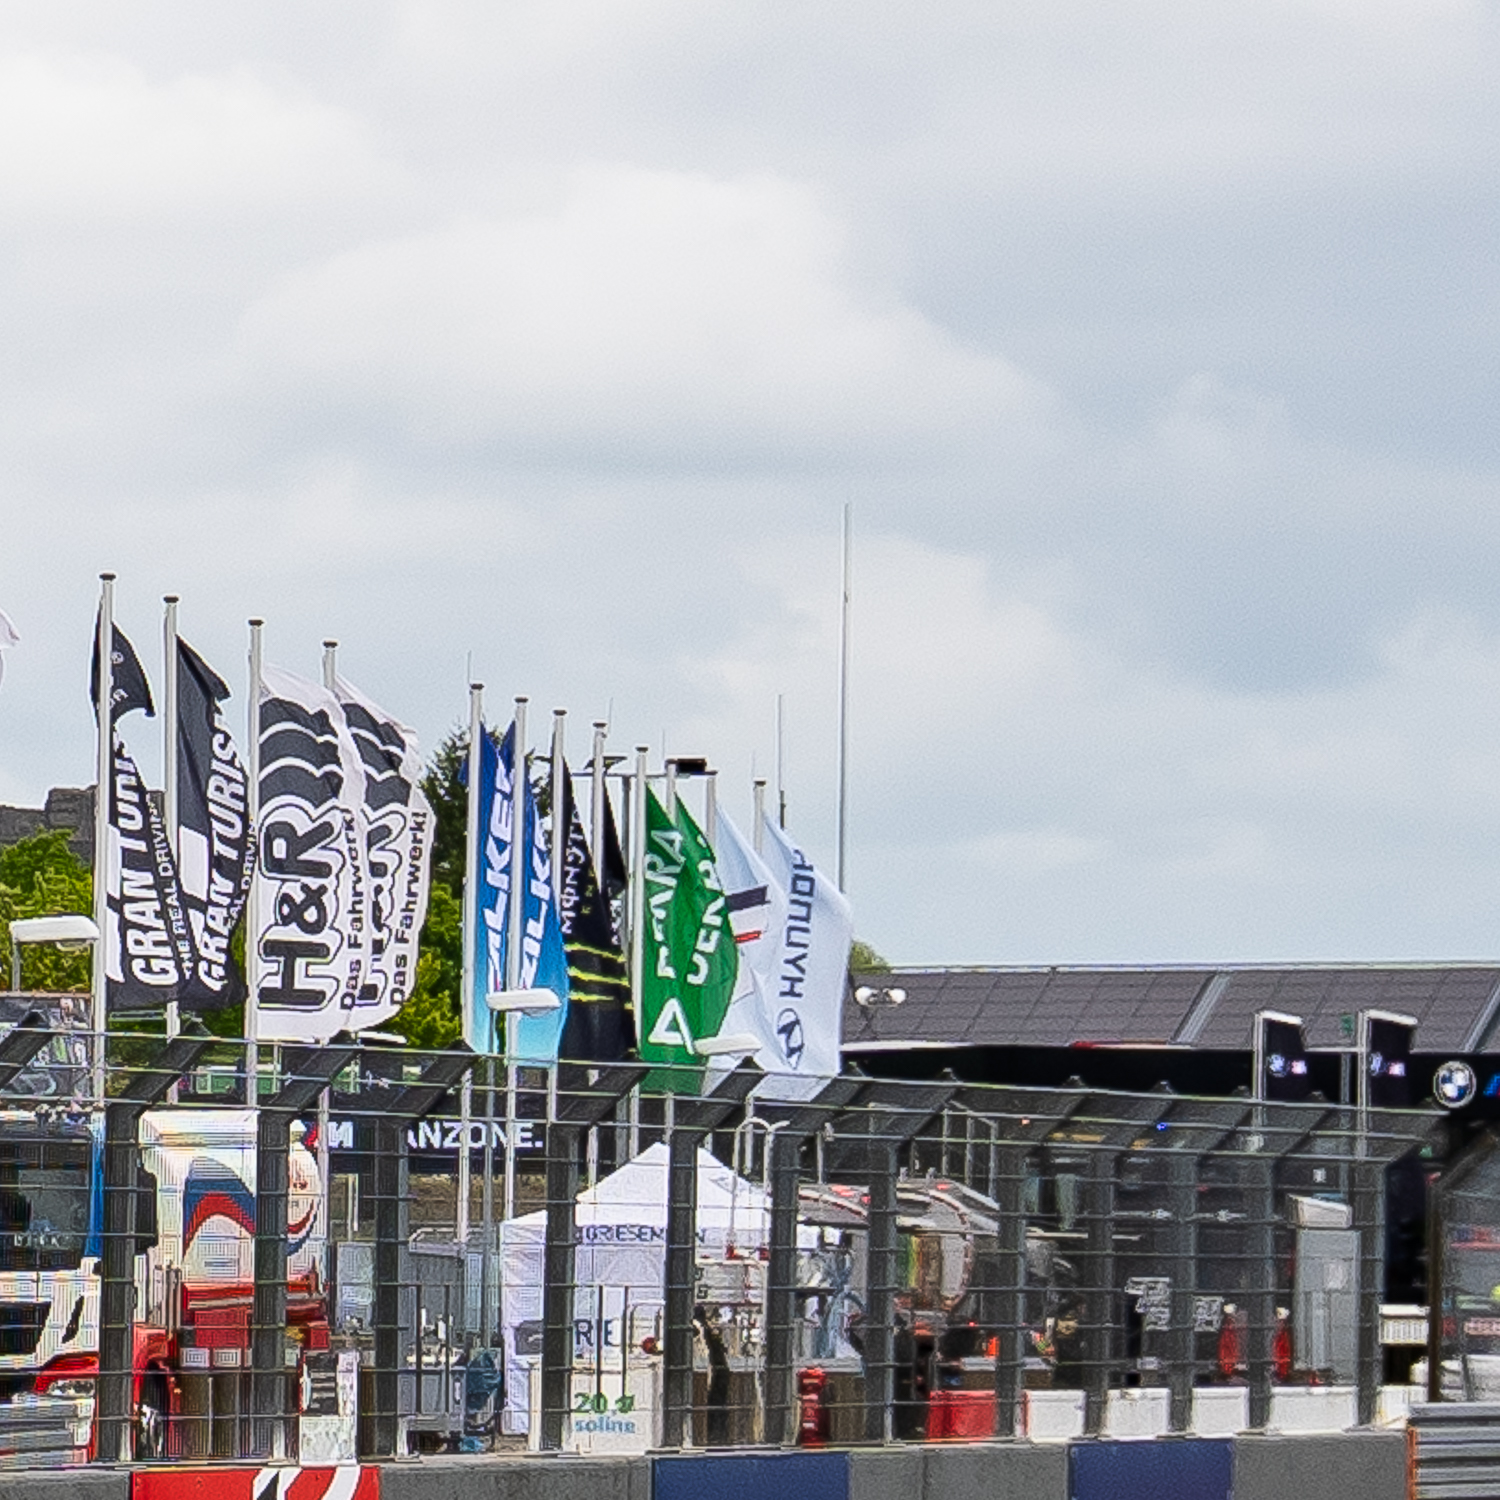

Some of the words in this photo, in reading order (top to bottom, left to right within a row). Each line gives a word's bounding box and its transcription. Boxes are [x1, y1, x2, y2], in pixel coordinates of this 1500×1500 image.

[117, 869, 180, 986] GRAN
[166, 880, 190, 935] REAL
[257, 803, 345, 1012] H&R
[341, 809, 366, 950] Fahrwerk!
[394, 811, 427, 944] Fahrwerk!
[340, 957, 362, 1011] Das
[390, 953, 408, 1005] Das
